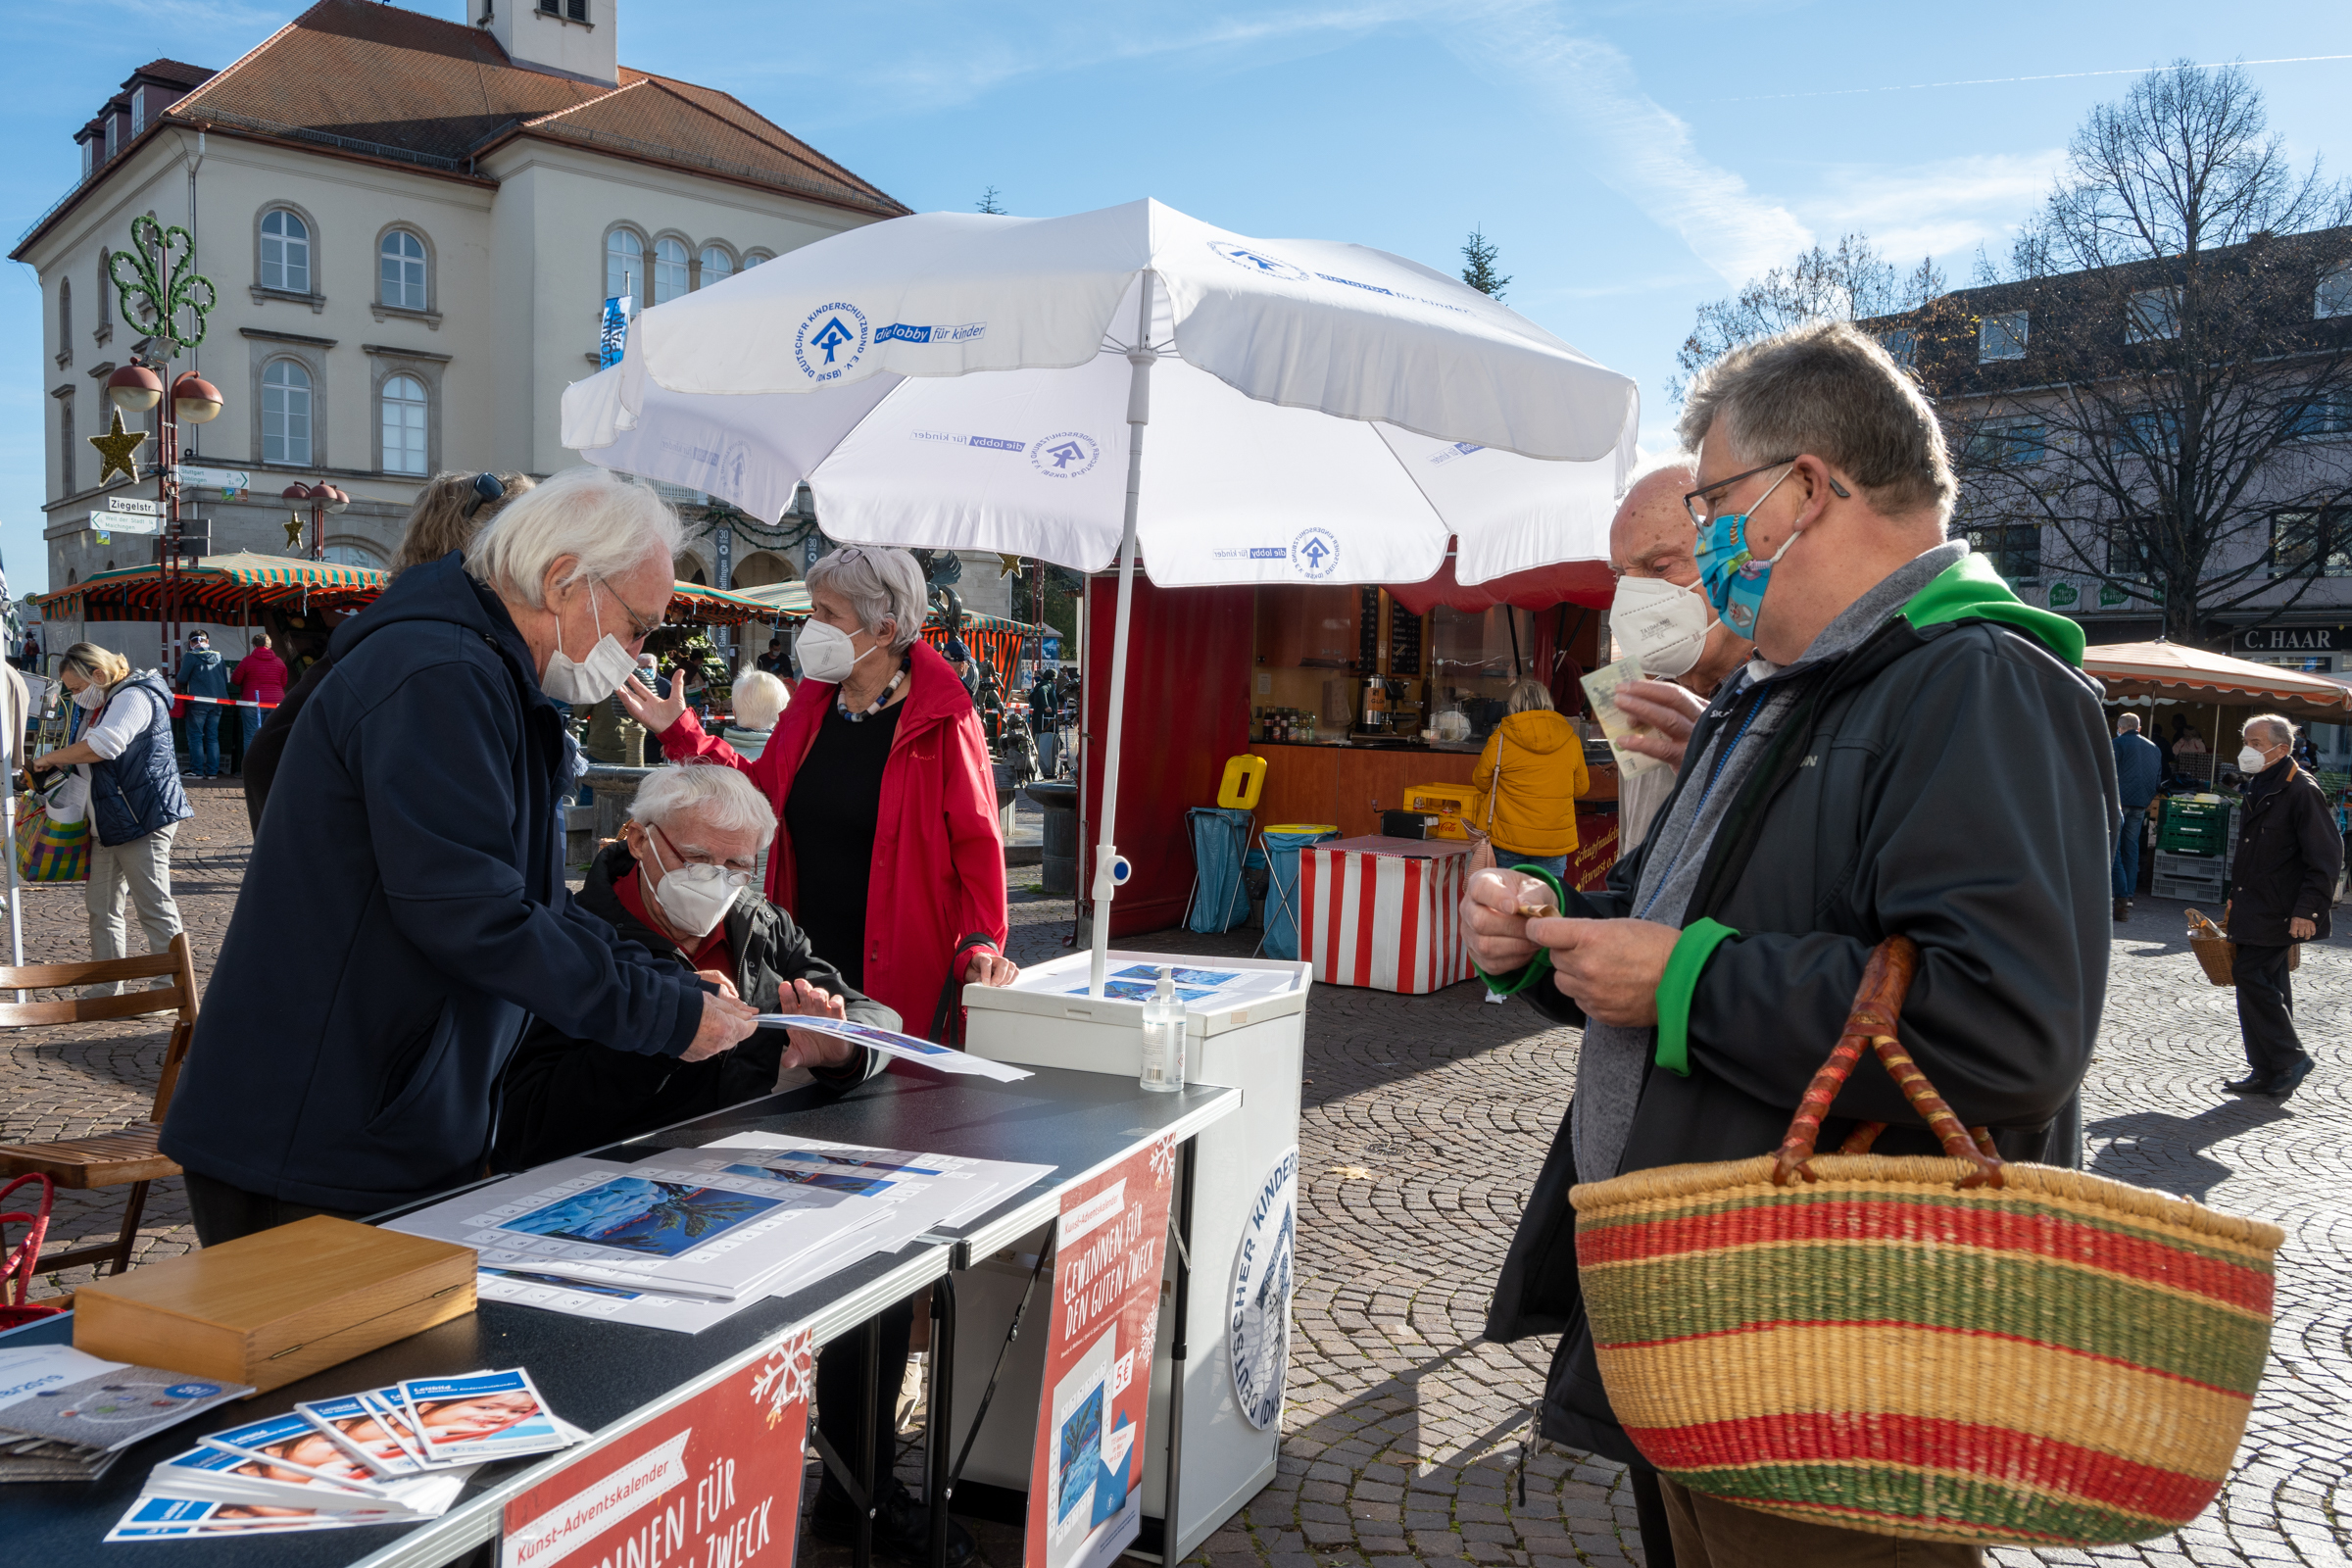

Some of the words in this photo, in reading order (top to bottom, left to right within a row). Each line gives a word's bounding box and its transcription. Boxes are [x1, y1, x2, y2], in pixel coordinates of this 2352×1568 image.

[602, 318, 613, 370] YOND
[612, 313, 626, 353] PAIN
[875, 328, 892, 341] die
[892, 324, 929, 342] lobby
[932, 327, 949, 342] für
[953, 325, 985, 340] kinder
[180, 467, 205, 476] Stuttgart
[111, 499, 155, 513] Ziegelstr.
[718, 530, 729, 540] 30
[808, 538, 817, 548] 30
[719, 560, 729, 591] delfingen
[2244, 630, 2264, 649] C.
[2270, 629, 2331, 649] HAAR
[1251, 1151, 1298, 1232] KINDERS
[1064, 1195, 1119, 1235] Kunst-Adventskalender
[1063, 1220, 1124, 1304] GEWINNEN
[1125, 1200, 1143, 1248] FÜR
[1064, 1291, 1089, 1342] DEN
[1091, 1261, 1125, 1318] GUTEN
[1125, 1236, 1156, 1290] ZWECK
[516, 1459, 669, 1566] Kunst-Adventskalender
[696, 1457, 736, 1535] FÜR
[706, 1495, 773, 1568] ZWECK
